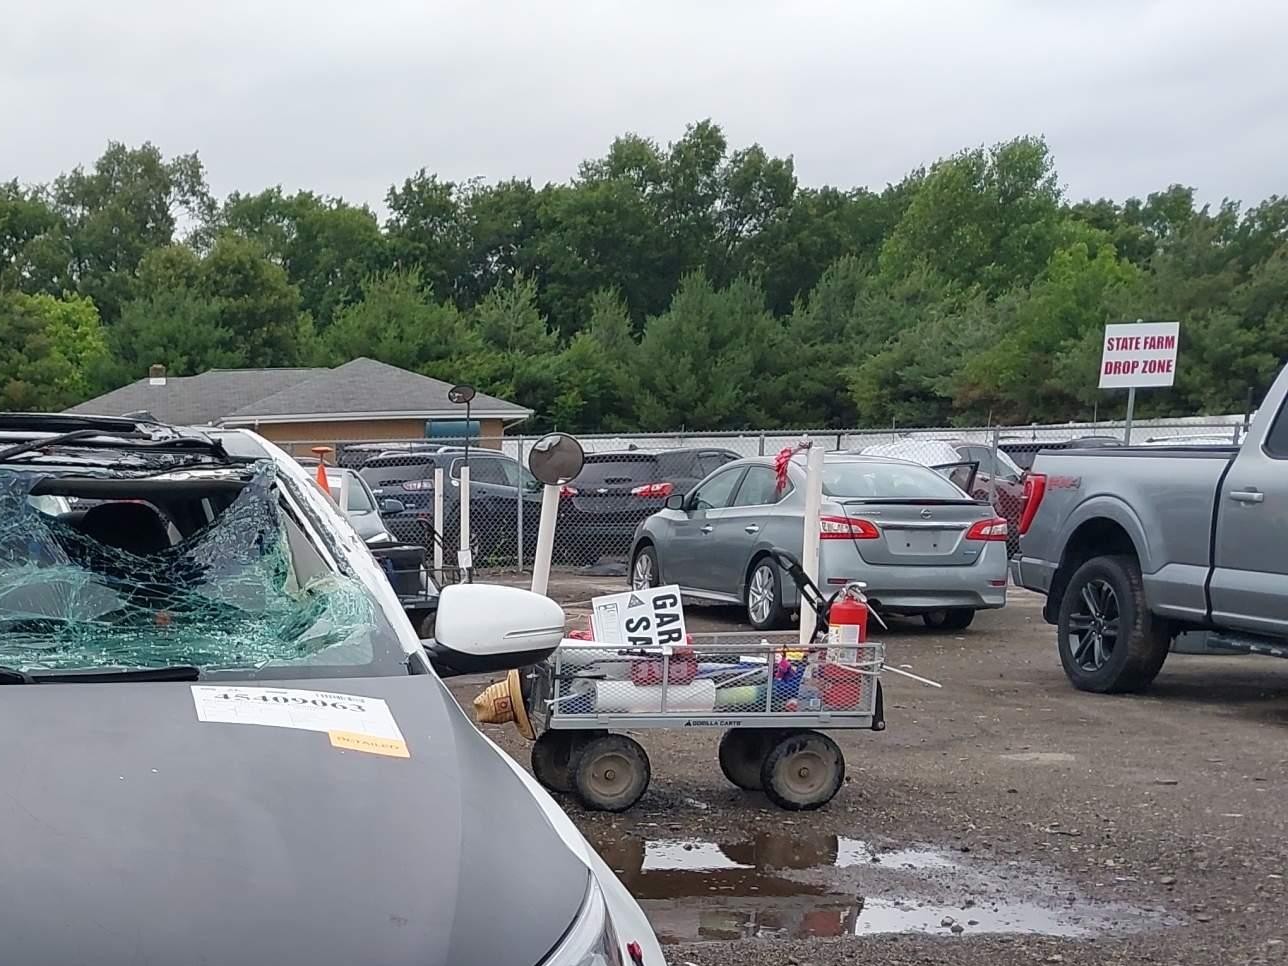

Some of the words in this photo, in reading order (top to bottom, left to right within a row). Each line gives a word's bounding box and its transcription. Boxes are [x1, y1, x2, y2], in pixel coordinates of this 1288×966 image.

[1107, 336, 1141, 351] STATE
[1143, 335, 1175, 350] FARM
[1104, 360, 1139, 375] DROP
[1141, 359, 1172, 374] ZONE
[214, 693, 366, 713] 45409063
